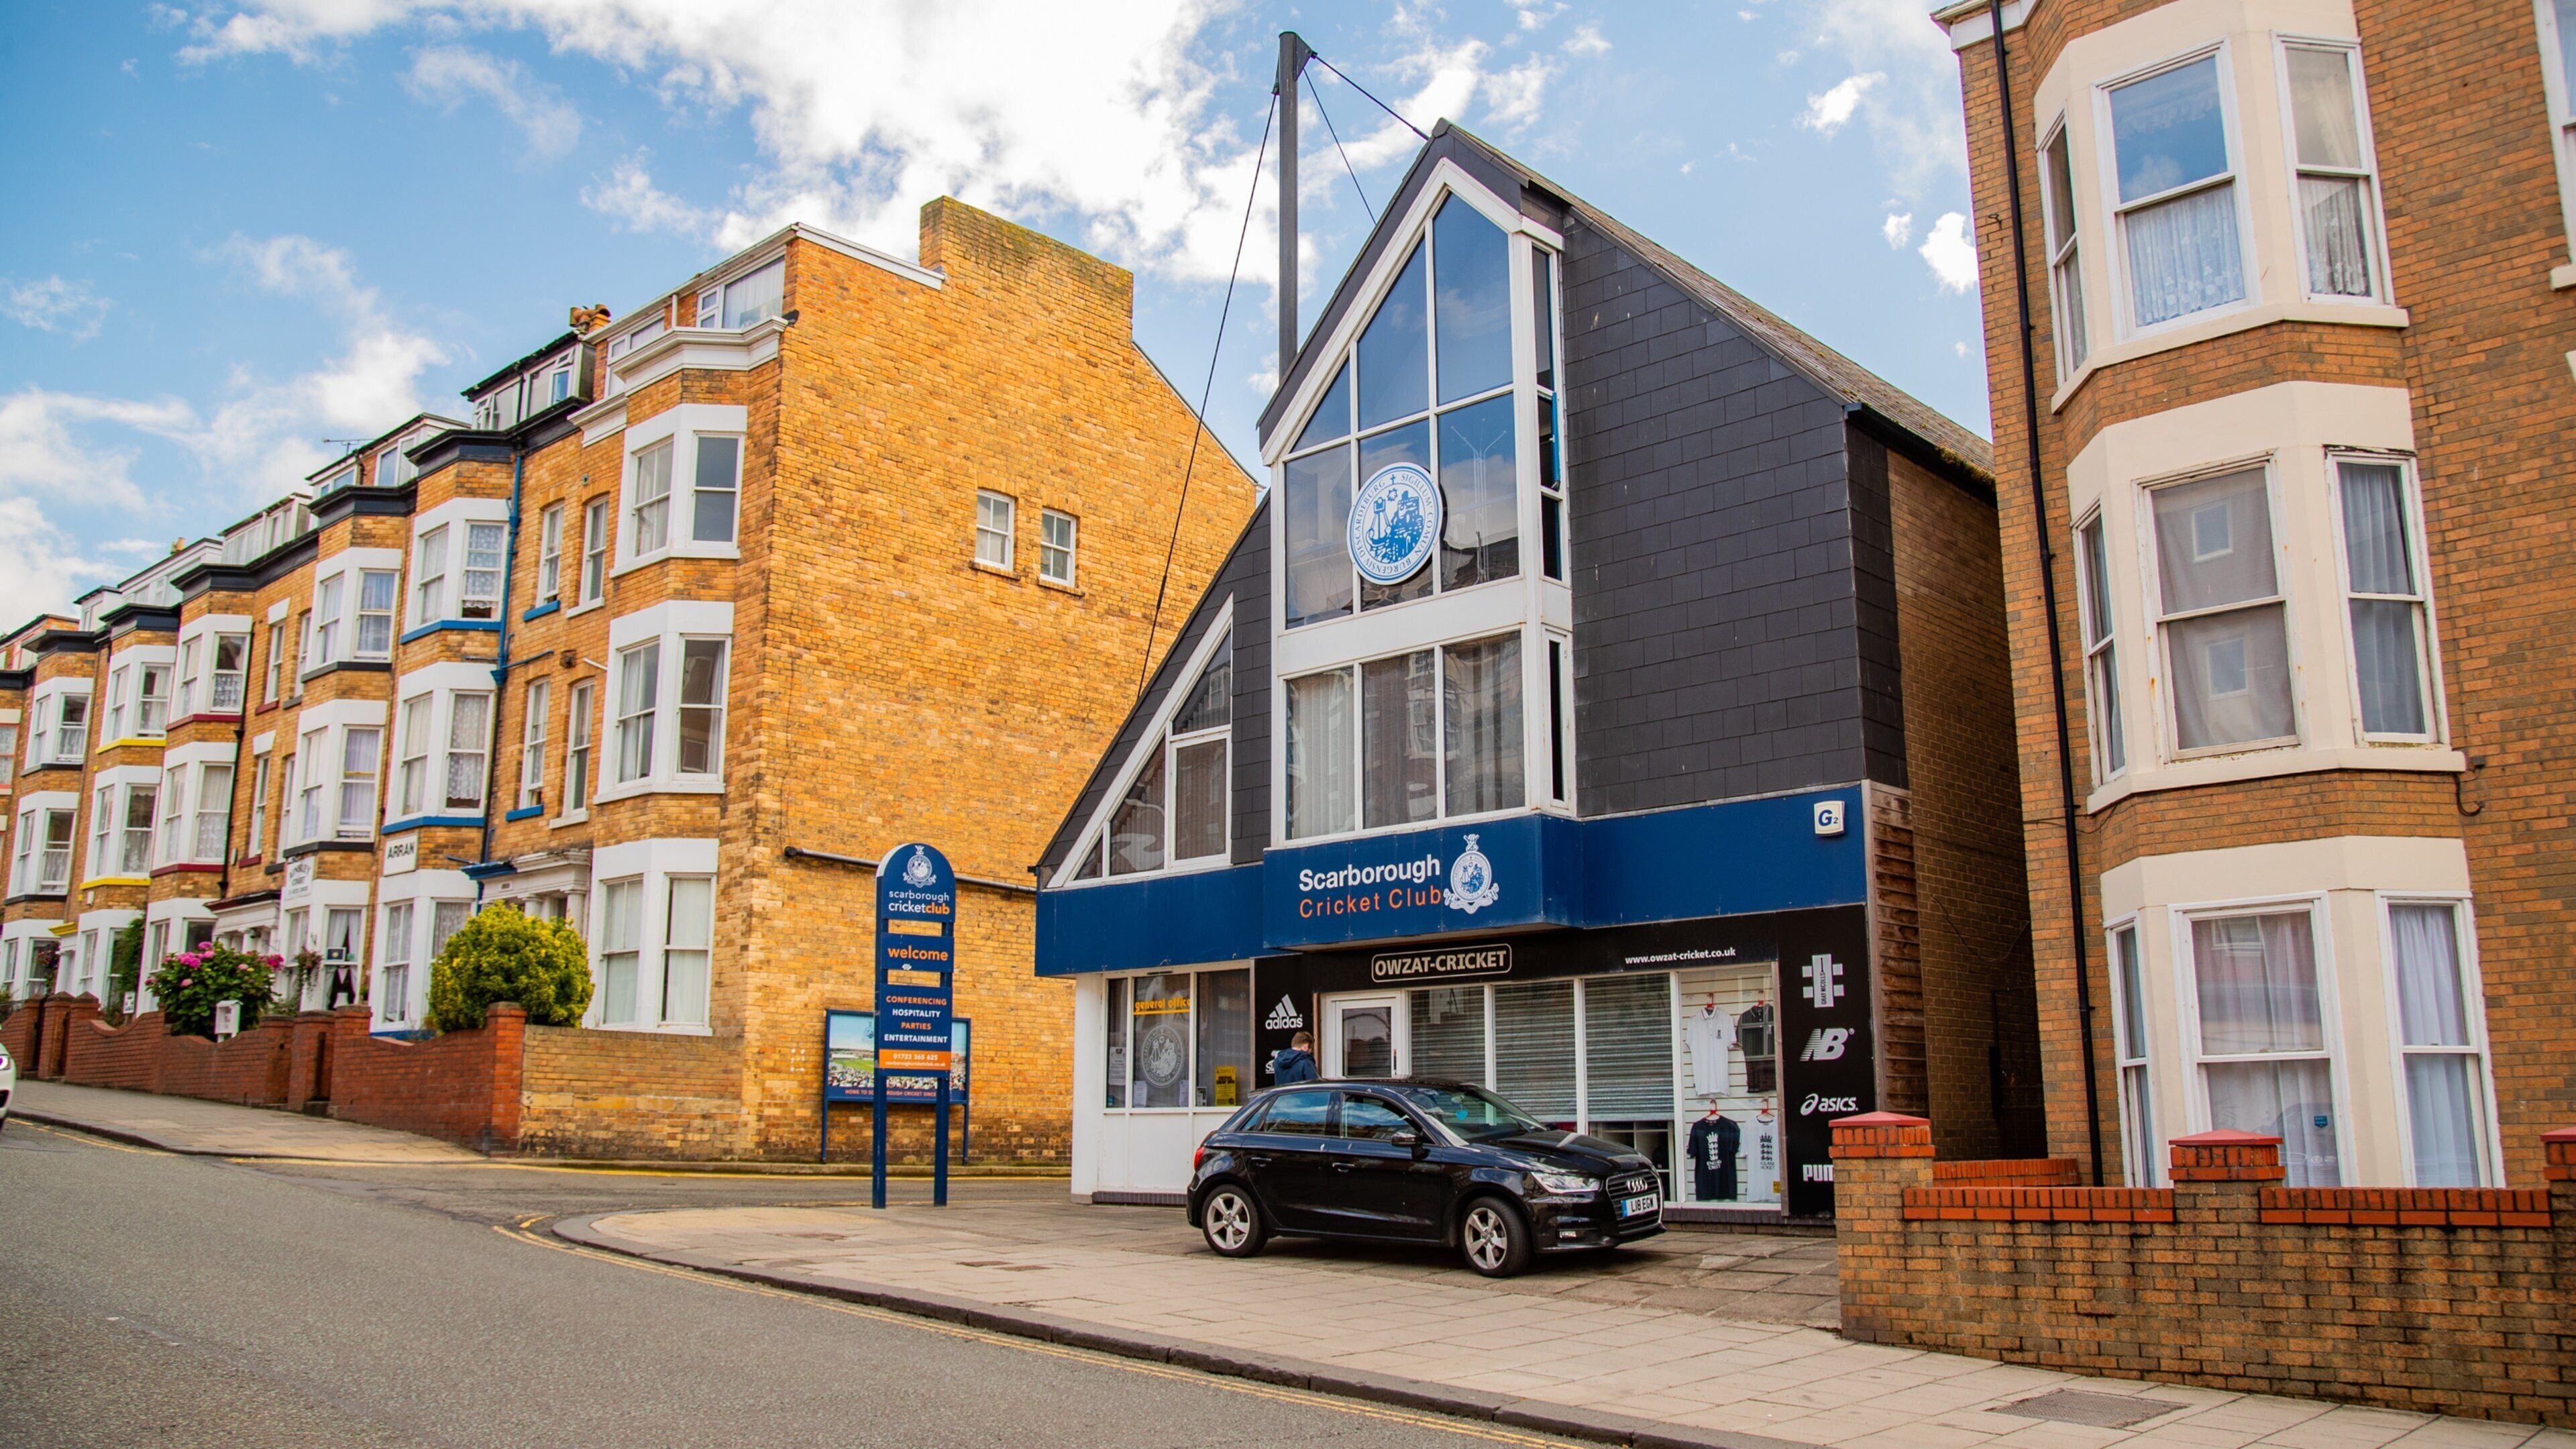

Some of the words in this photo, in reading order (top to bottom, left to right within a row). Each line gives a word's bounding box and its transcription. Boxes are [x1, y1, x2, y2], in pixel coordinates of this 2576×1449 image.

[387, 841, 415, 859] ARRAN
[1299, 854, 1440, 892] Scarborough
[889, 890, 949, 903] scarborough
[1299, 893, 1380, 918] Cricket
[1389, 885, 1441, 909] Club
[888, 900, 950, 914] cricketclub
[888, 945, 948, 961] welcome
[1625, 947, 1736, 964] www.owzat-cricket.co.uk
[1375, 951, 1506, 976] OWZAT-CRICKET
[886, 996, 947, 1006] CONFERENCING
[1135, 998, 1165, 1012] general
[892, 1009, 941, 1018] HOSPITALITY
[1265, 1016, 1303, 1030] adidas
[884, 1034, 948, 1043] ENTERTAINMENT
[1803, 1165, 1833, 1181] PUM
